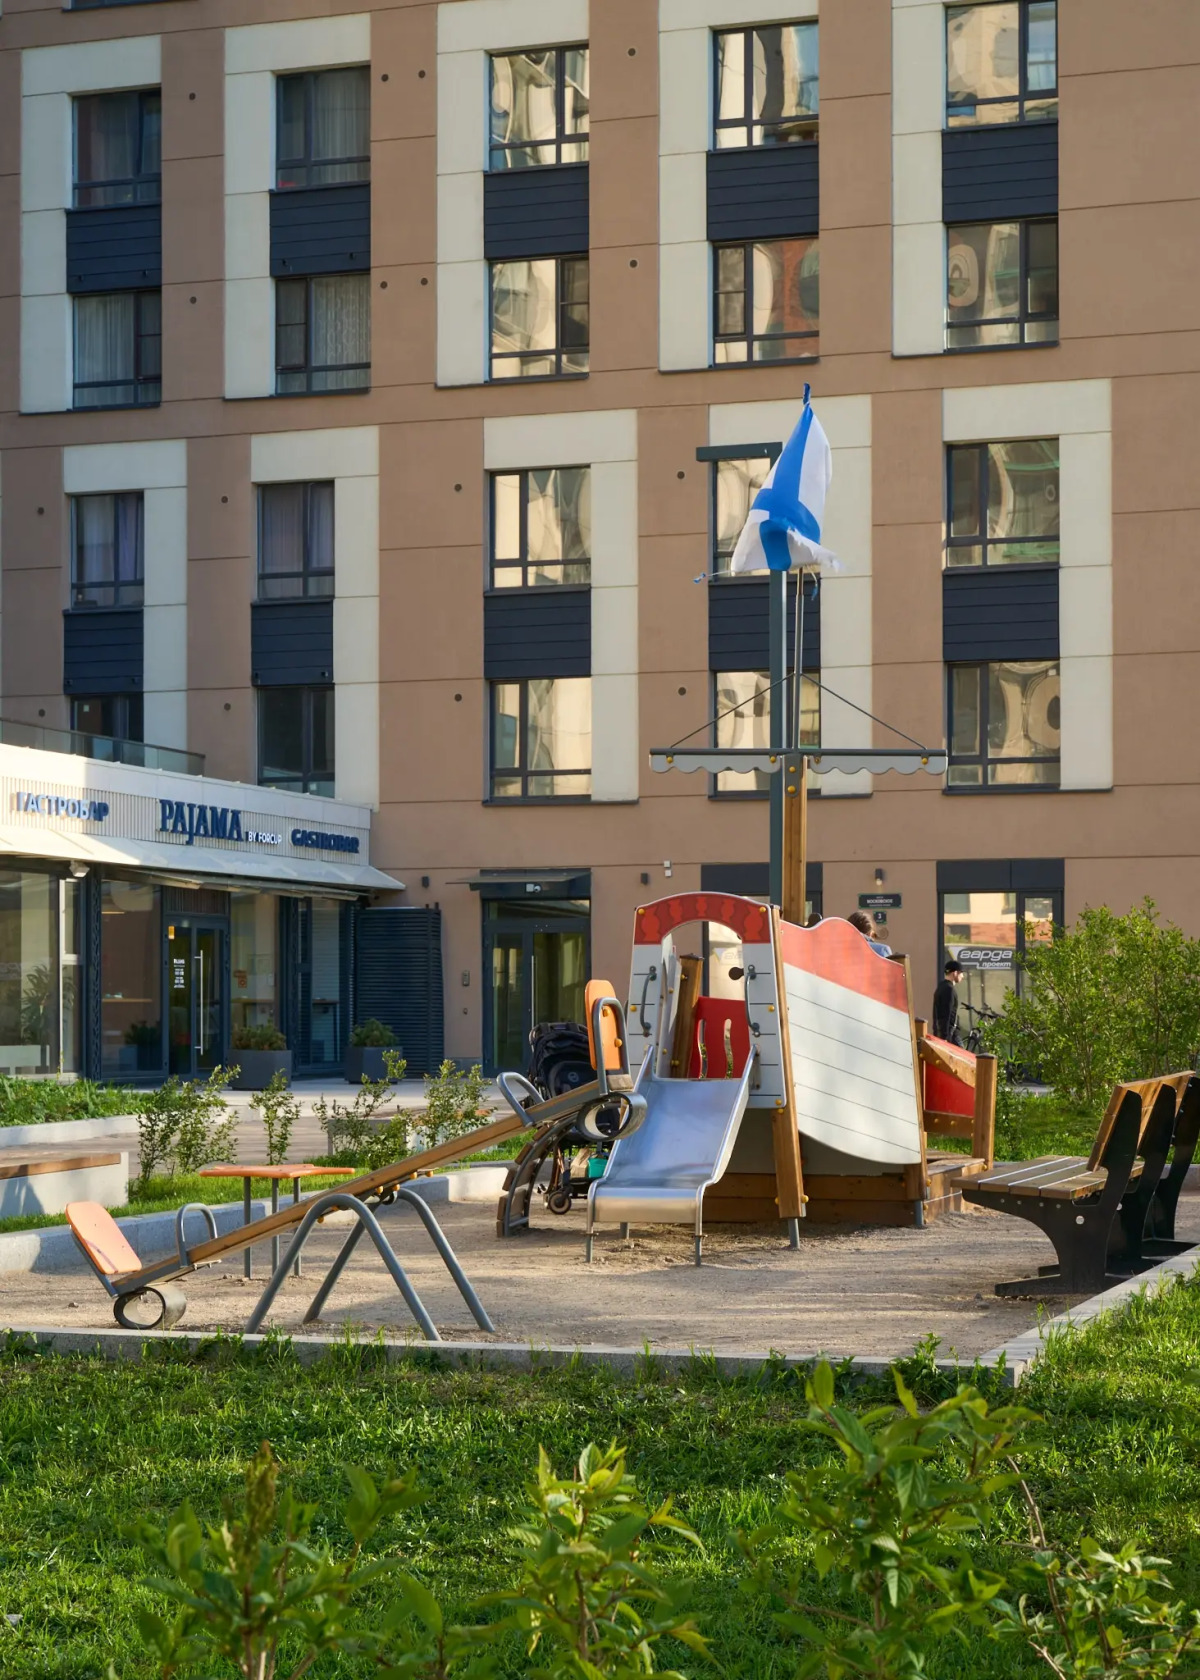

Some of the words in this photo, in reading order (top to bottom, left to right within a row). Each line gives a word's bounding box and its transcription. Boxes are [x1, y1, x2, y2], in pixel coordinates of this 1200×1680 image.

[16, 791, 109, 822] ГАСТРОБАР
[160, 799, 244, 845] PAJAMA
[247, 831, 257, 842] BY
[258, 832, 283, 845] FORCUP
